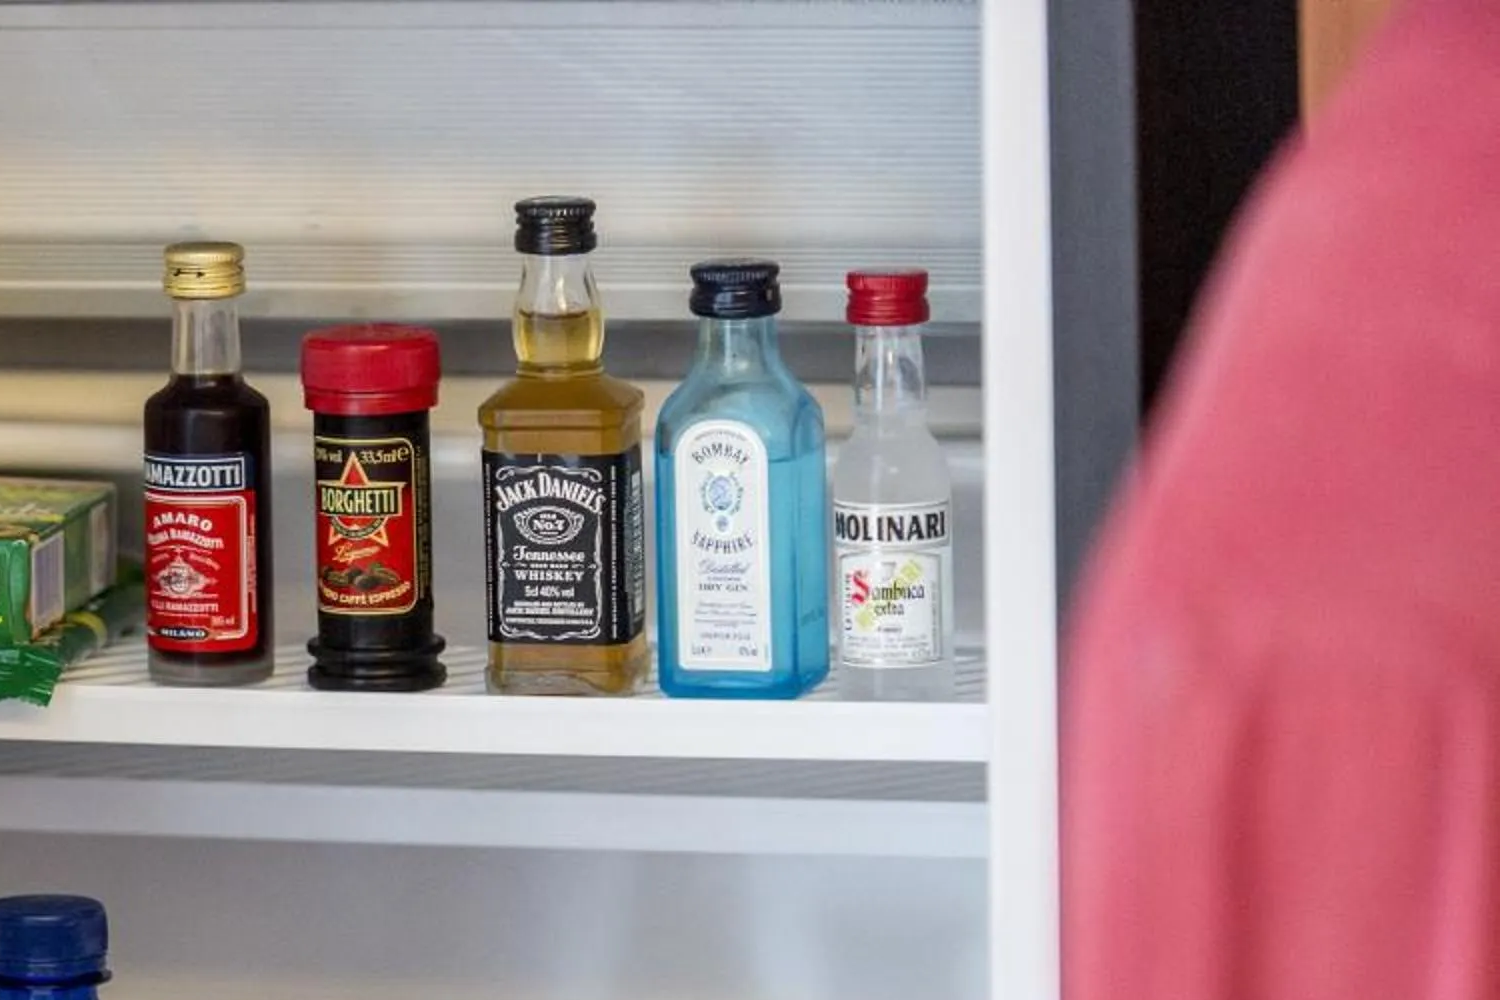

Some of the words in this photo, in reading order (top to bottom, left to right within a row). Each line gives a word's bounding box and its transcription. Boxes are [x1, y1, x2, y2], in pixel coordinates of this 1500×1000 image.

[495, 478, 538, 512] JACK
[153, 512, 213, 532] AMARO
[513, 545, 586, 562] Tennessee
[691, 529, 754, 555] SAPPHIRE
[513, 570, 585, 582] WHISKEY
[851, 570, 925, 604] Sambuca
